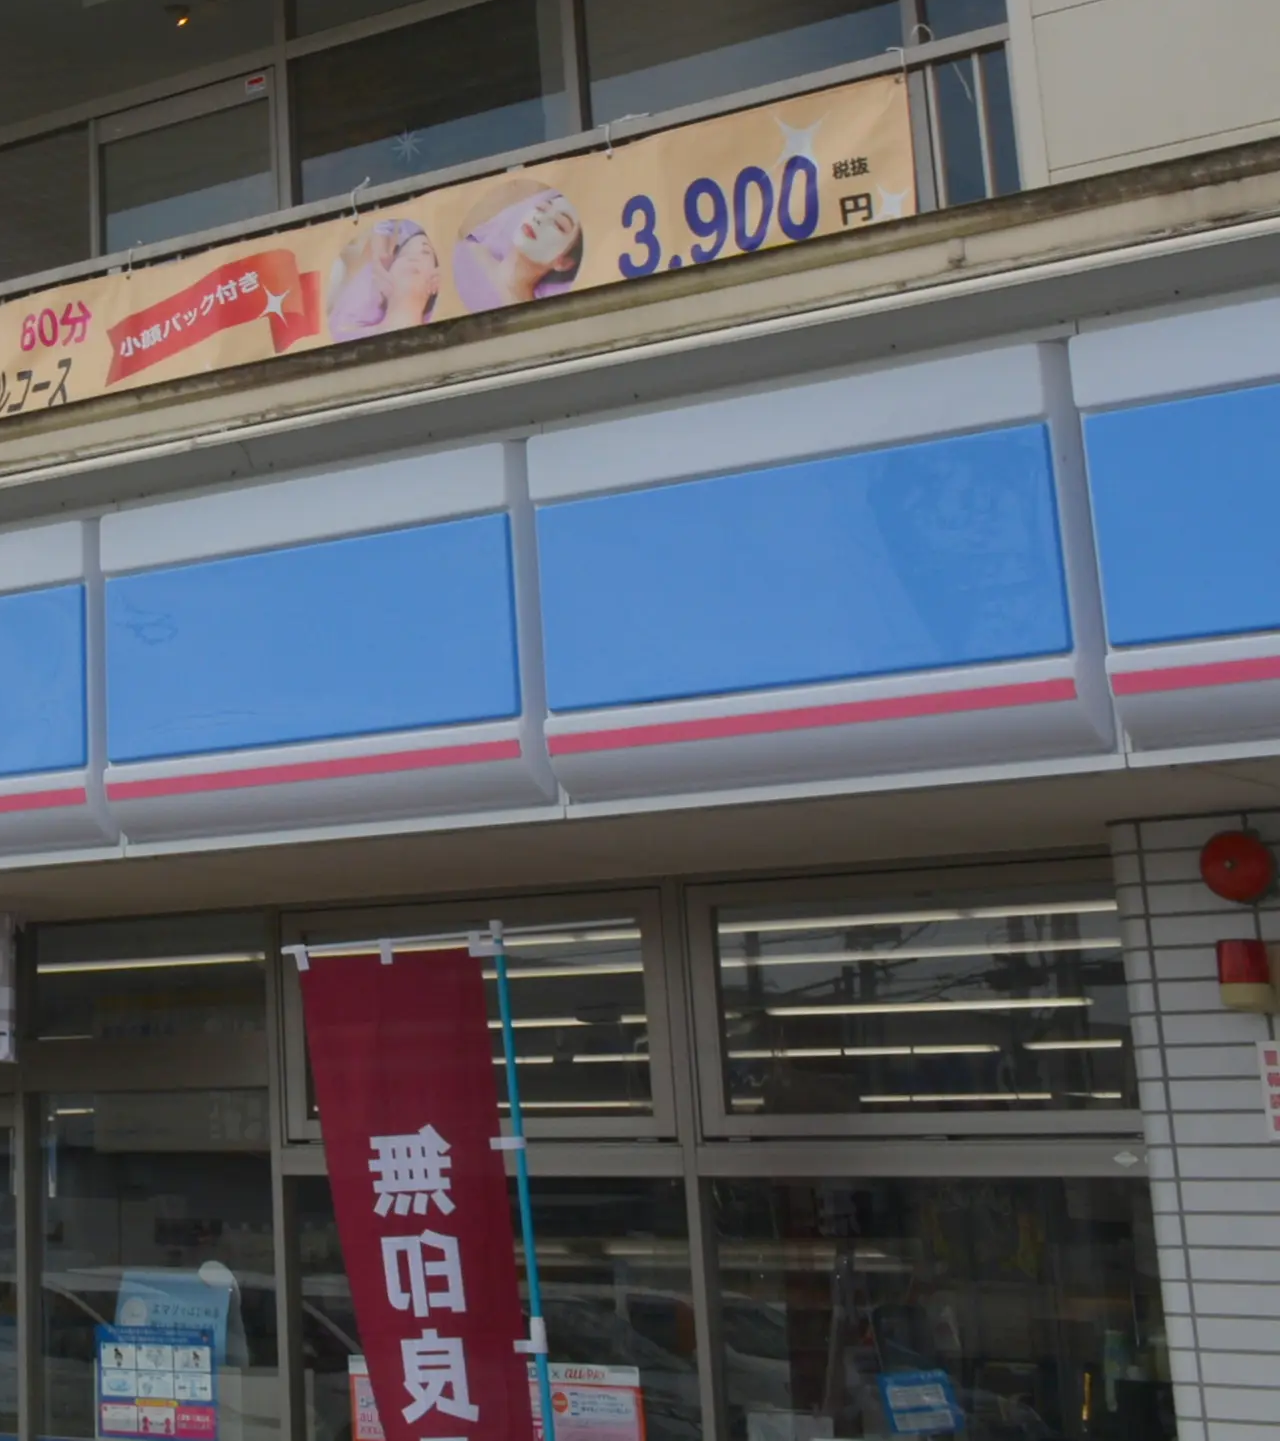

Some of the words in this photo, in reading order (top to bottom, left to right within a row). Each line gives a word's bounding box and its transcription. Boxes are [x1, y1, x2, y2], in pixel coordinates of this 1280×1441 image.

[831, 155, 871, 182] 税抜
[839, 193, 873, 227] 円
[19, 299, 93, 352] 60分
[119, 269, 262, 360] 小顔パック付き
